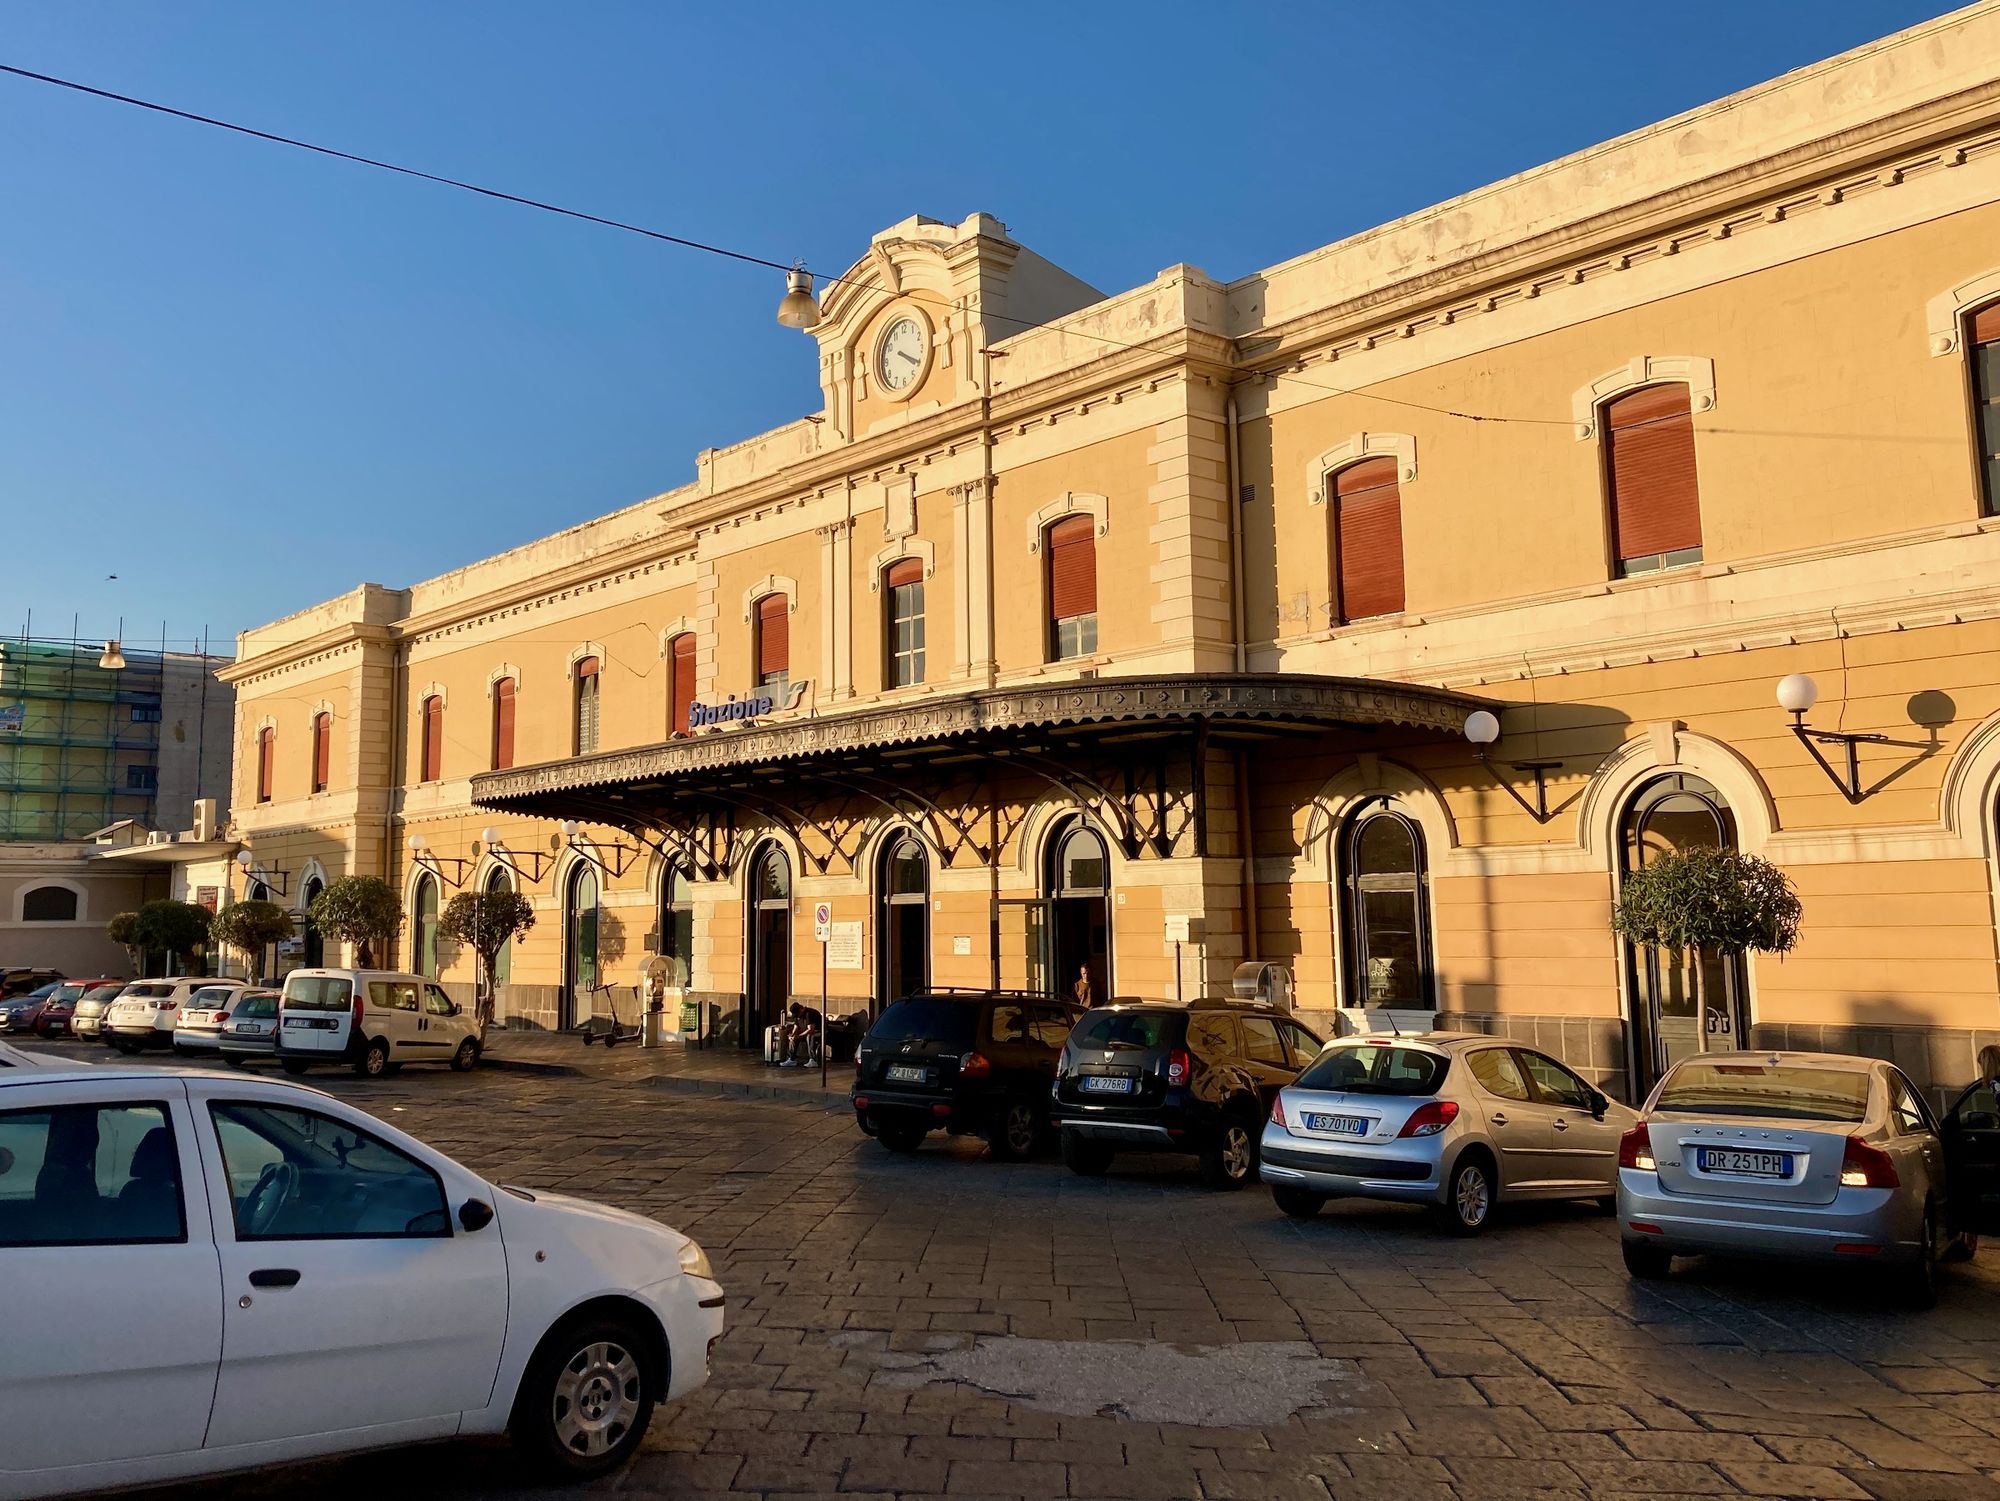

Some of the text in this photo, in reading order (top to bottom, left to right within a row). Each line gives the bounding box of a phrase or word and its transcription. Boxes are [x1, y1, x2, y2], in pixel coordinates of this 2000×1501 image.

[901, 324, 907, 334] 12
[893, 332, 898, 341] 11
[688, 694, 773, 727] Stazione
[1102, 1078, 1127, 1090] 276RB
[1313, 1116, 1360, 1132] ES 701VD
[1693, 1128, 1793, 1141] VOLVO
[1708, 1151, 1782, 1172] DR 251PH
